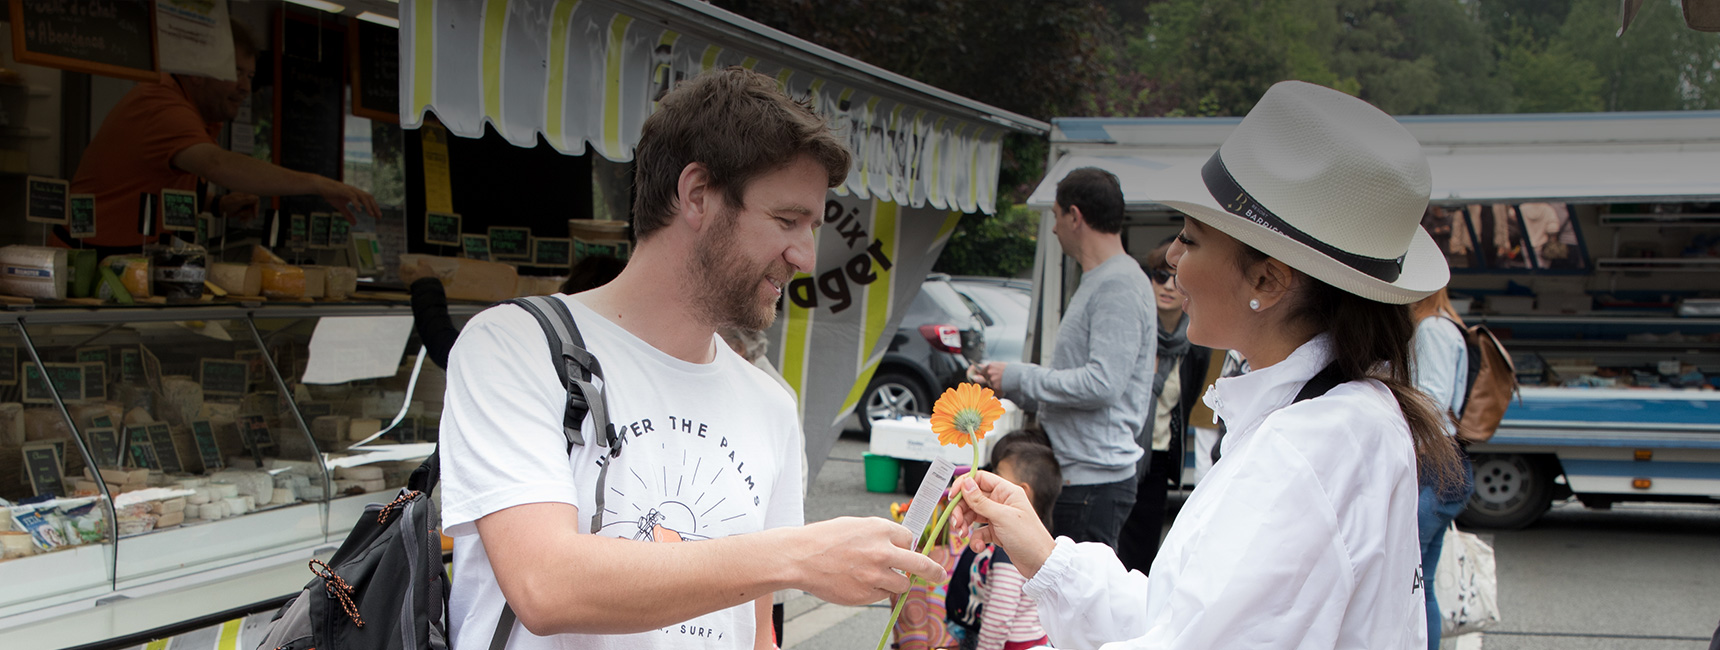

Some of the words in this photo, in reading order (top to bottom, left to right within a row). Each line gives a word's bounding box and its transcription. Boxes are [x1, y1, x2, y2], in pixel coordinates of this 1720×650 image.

[669, 415, 708, 438] THE
[720, 436, 760, 507] PALMS
[680, 624, 713, 638] SURF
